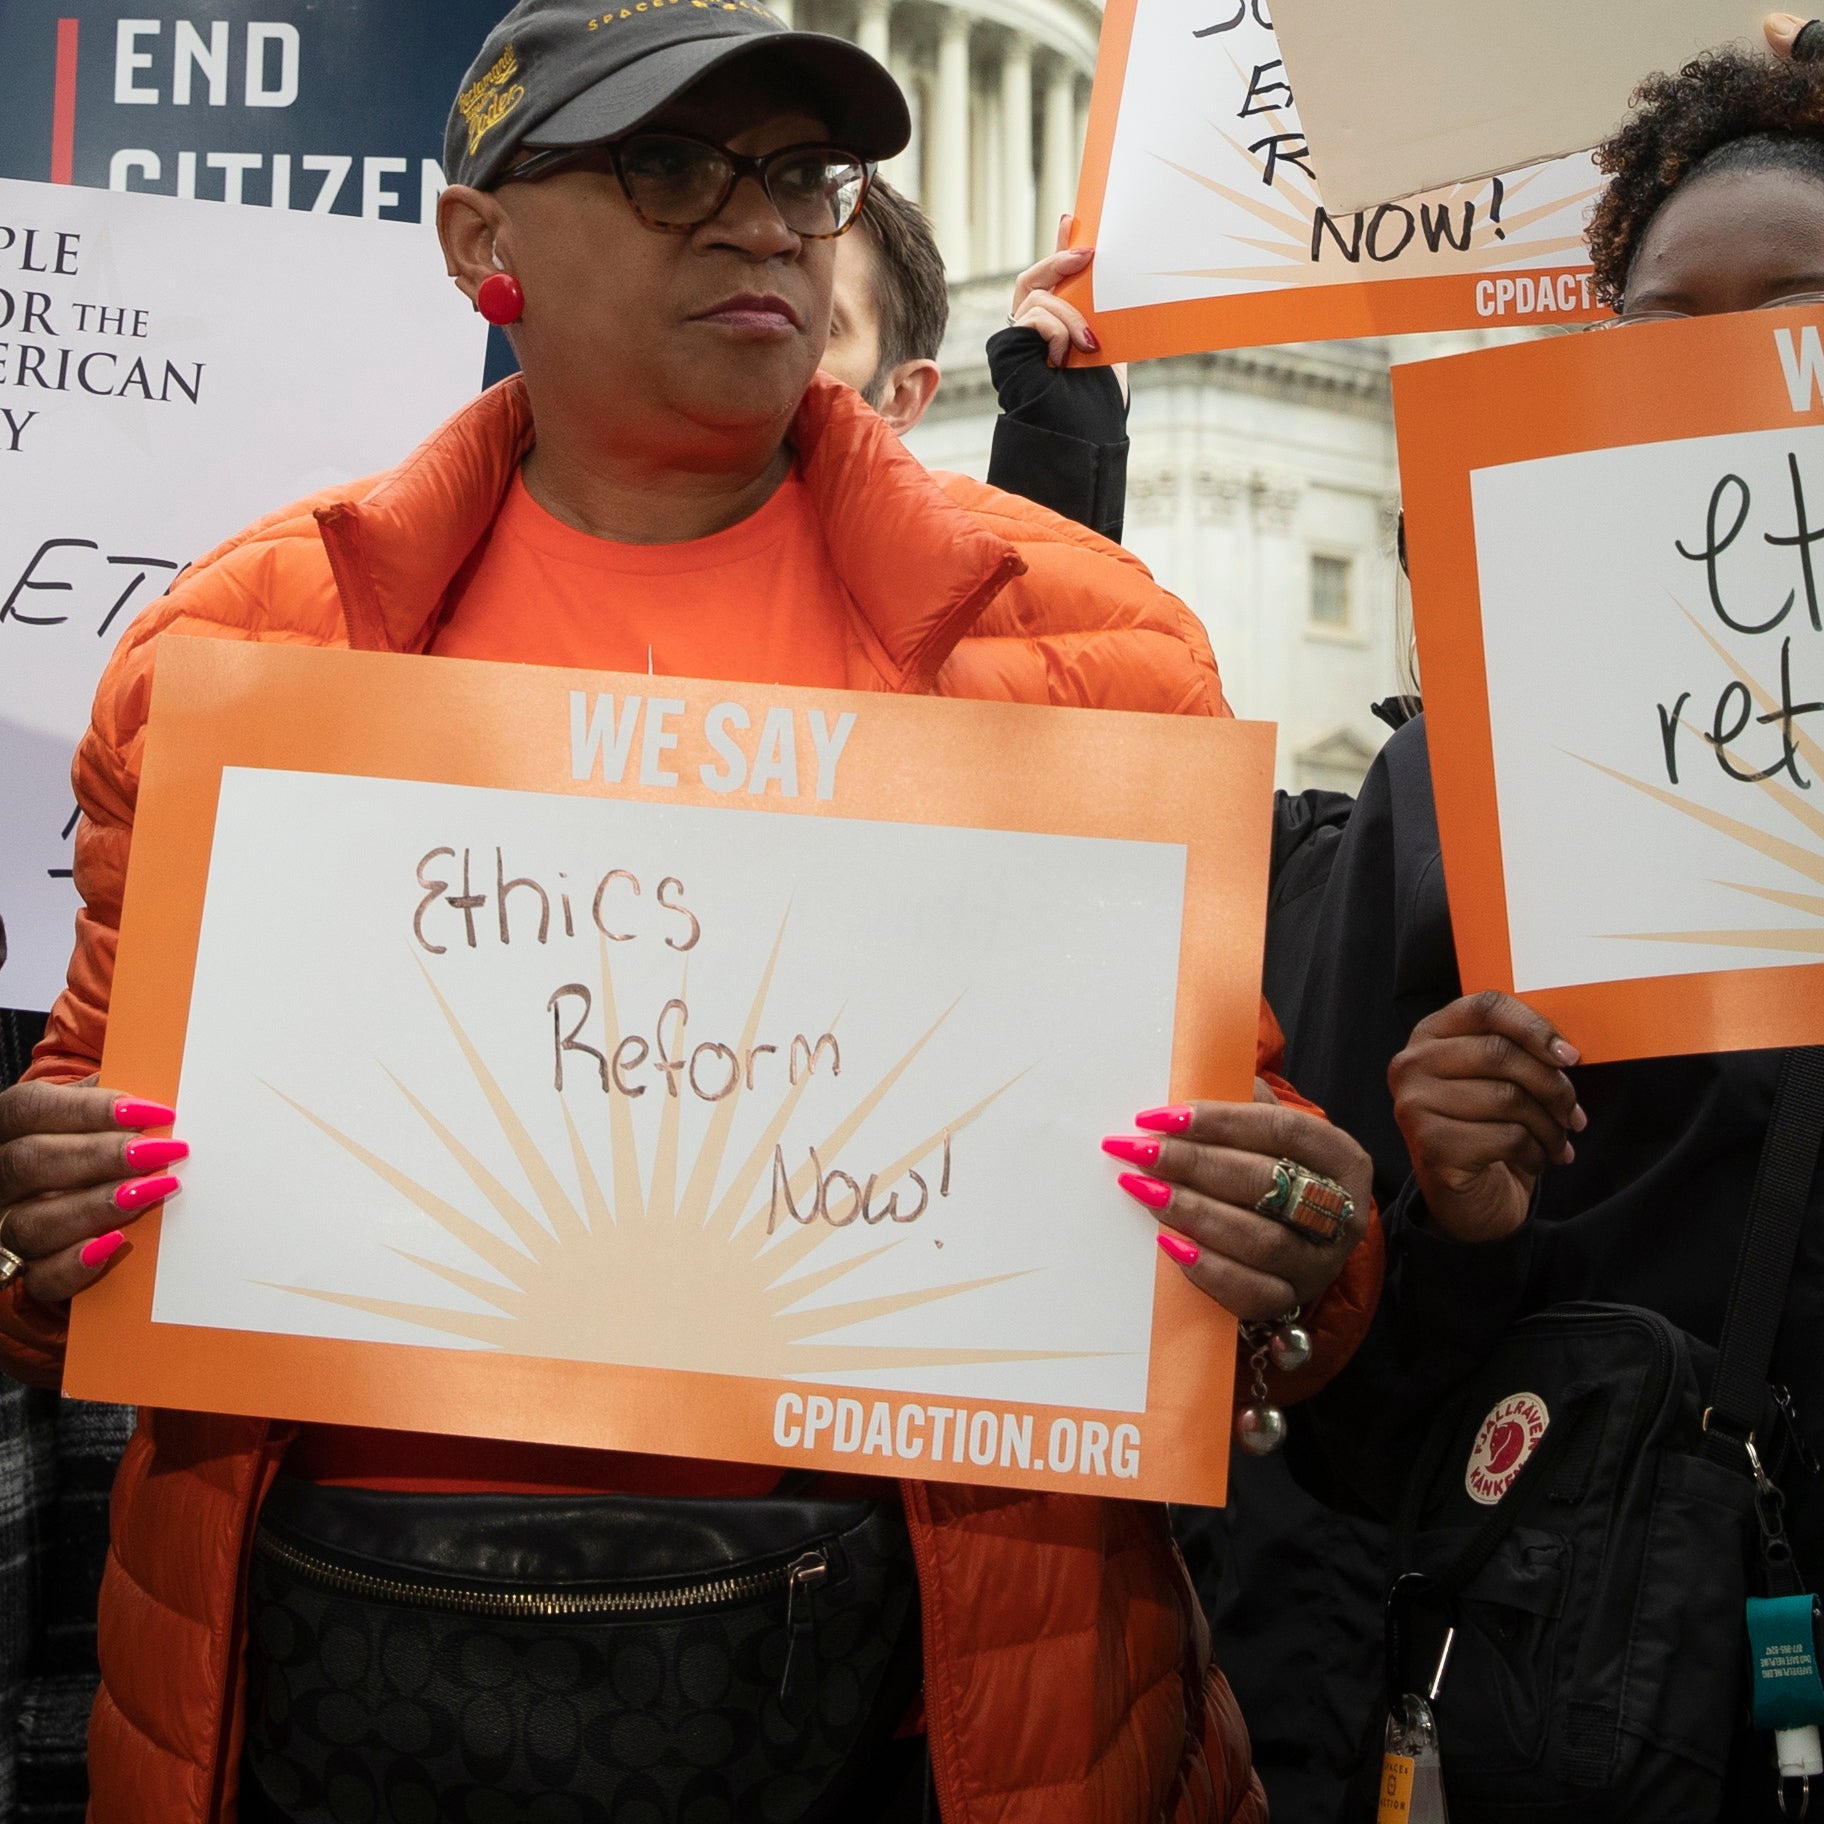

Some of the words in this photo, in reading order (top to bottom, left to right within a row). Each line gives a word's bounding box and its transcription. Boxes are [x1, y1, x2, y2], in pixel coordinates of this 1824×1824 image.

[114, 18, 300, 108] END
[1310, 177, 1506, 264] NOW!
[71, 301, 150, 340] THE
[569, 690, 678, 787] WE
[699, 701, 857, 801] SAY
[412, 845, 701, 956] Ethics
[547, 982, 842, 1102] Reform
[766, 1127, 951, 1249] Now!
[773, 1392, 1142, 1480] CPDACTION.ORG
